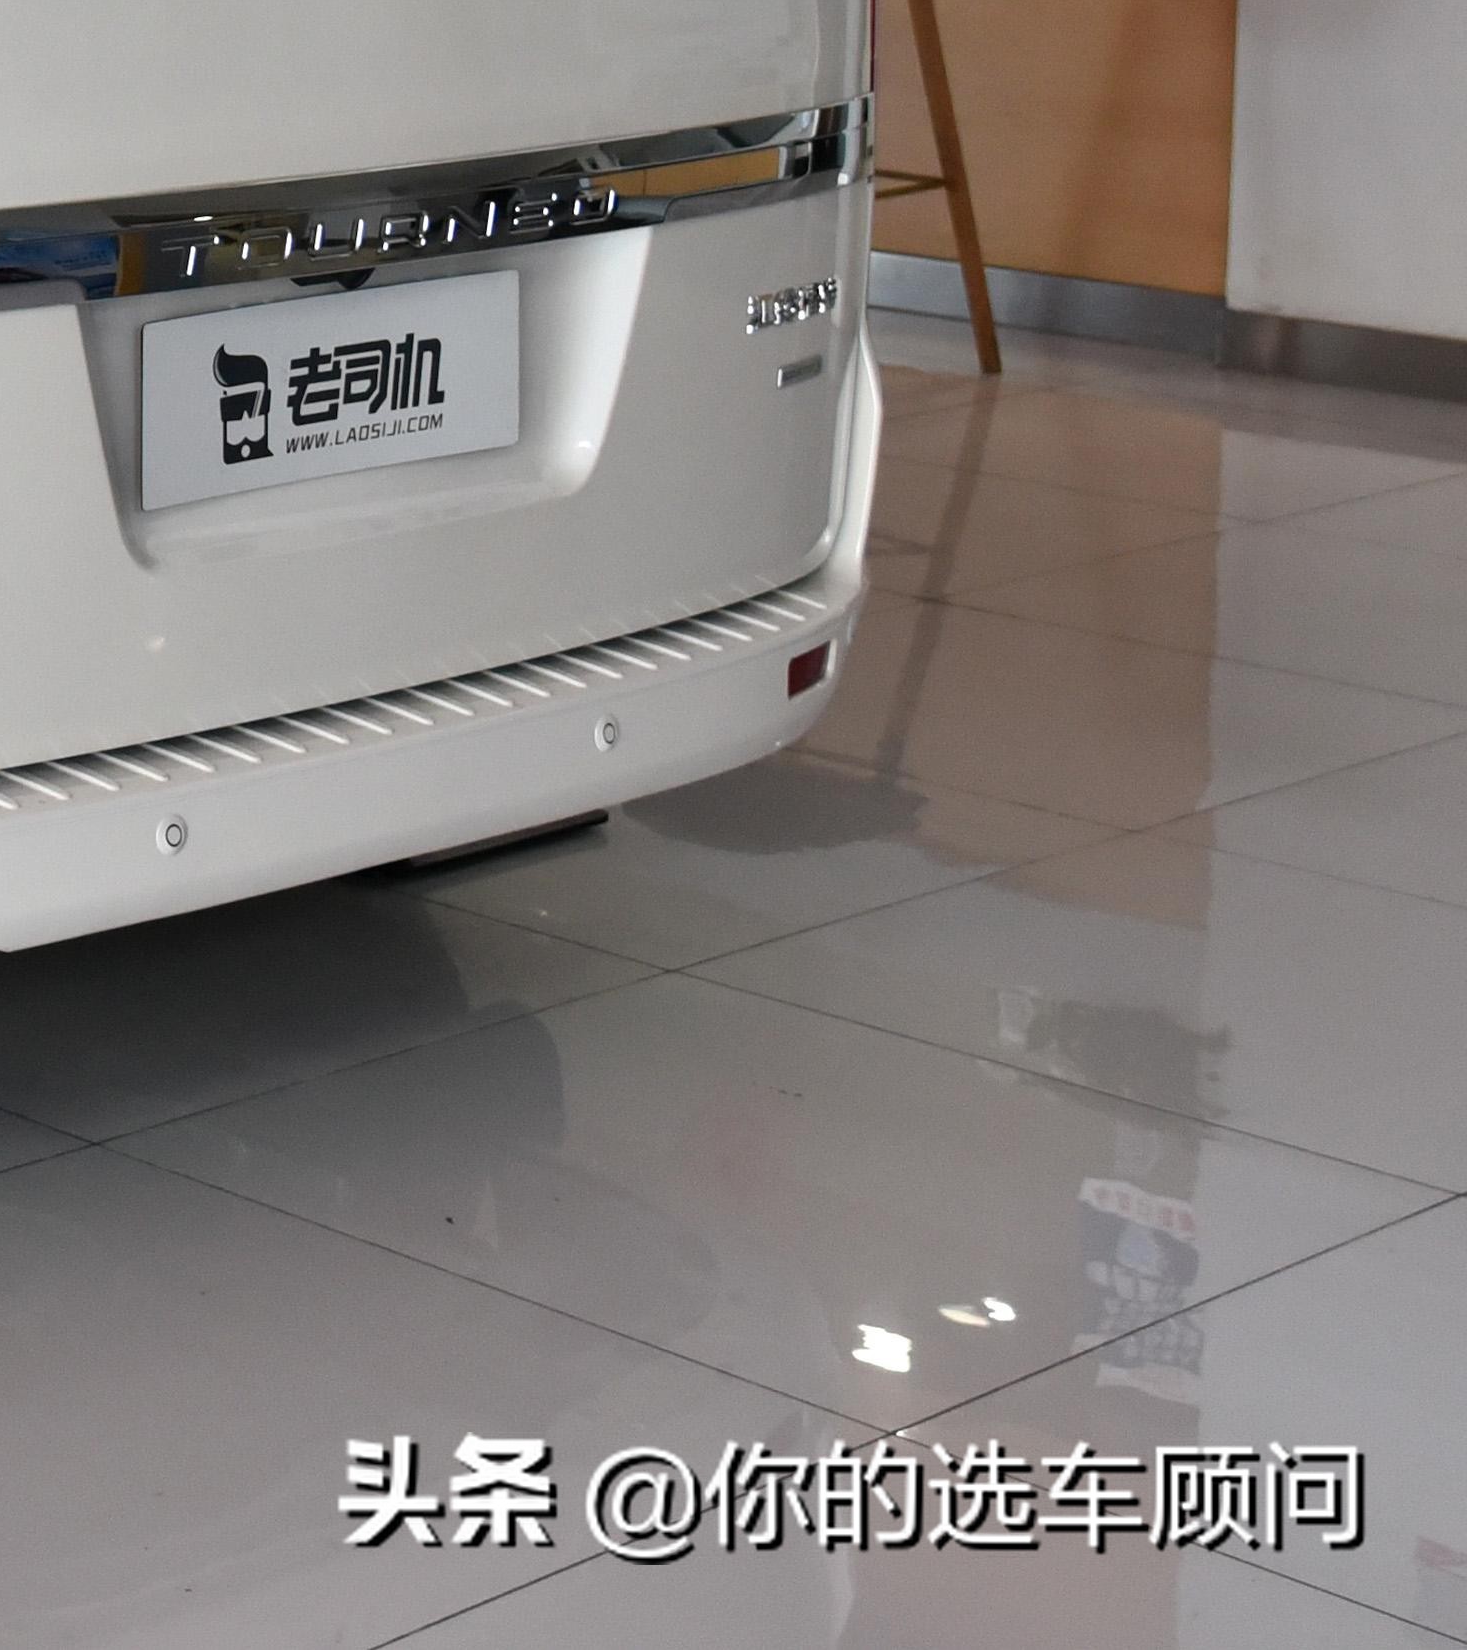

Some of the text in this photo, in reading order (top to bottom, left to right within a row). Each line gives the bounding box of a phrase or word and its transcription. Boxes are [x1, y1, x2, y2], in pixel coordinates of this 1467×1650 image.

[161, 184, 619, 278] TOURNEO
[286, 333, 445, 427] 老司机
[285, 412, 445, 454] WWW.LAOSIJI.COM
